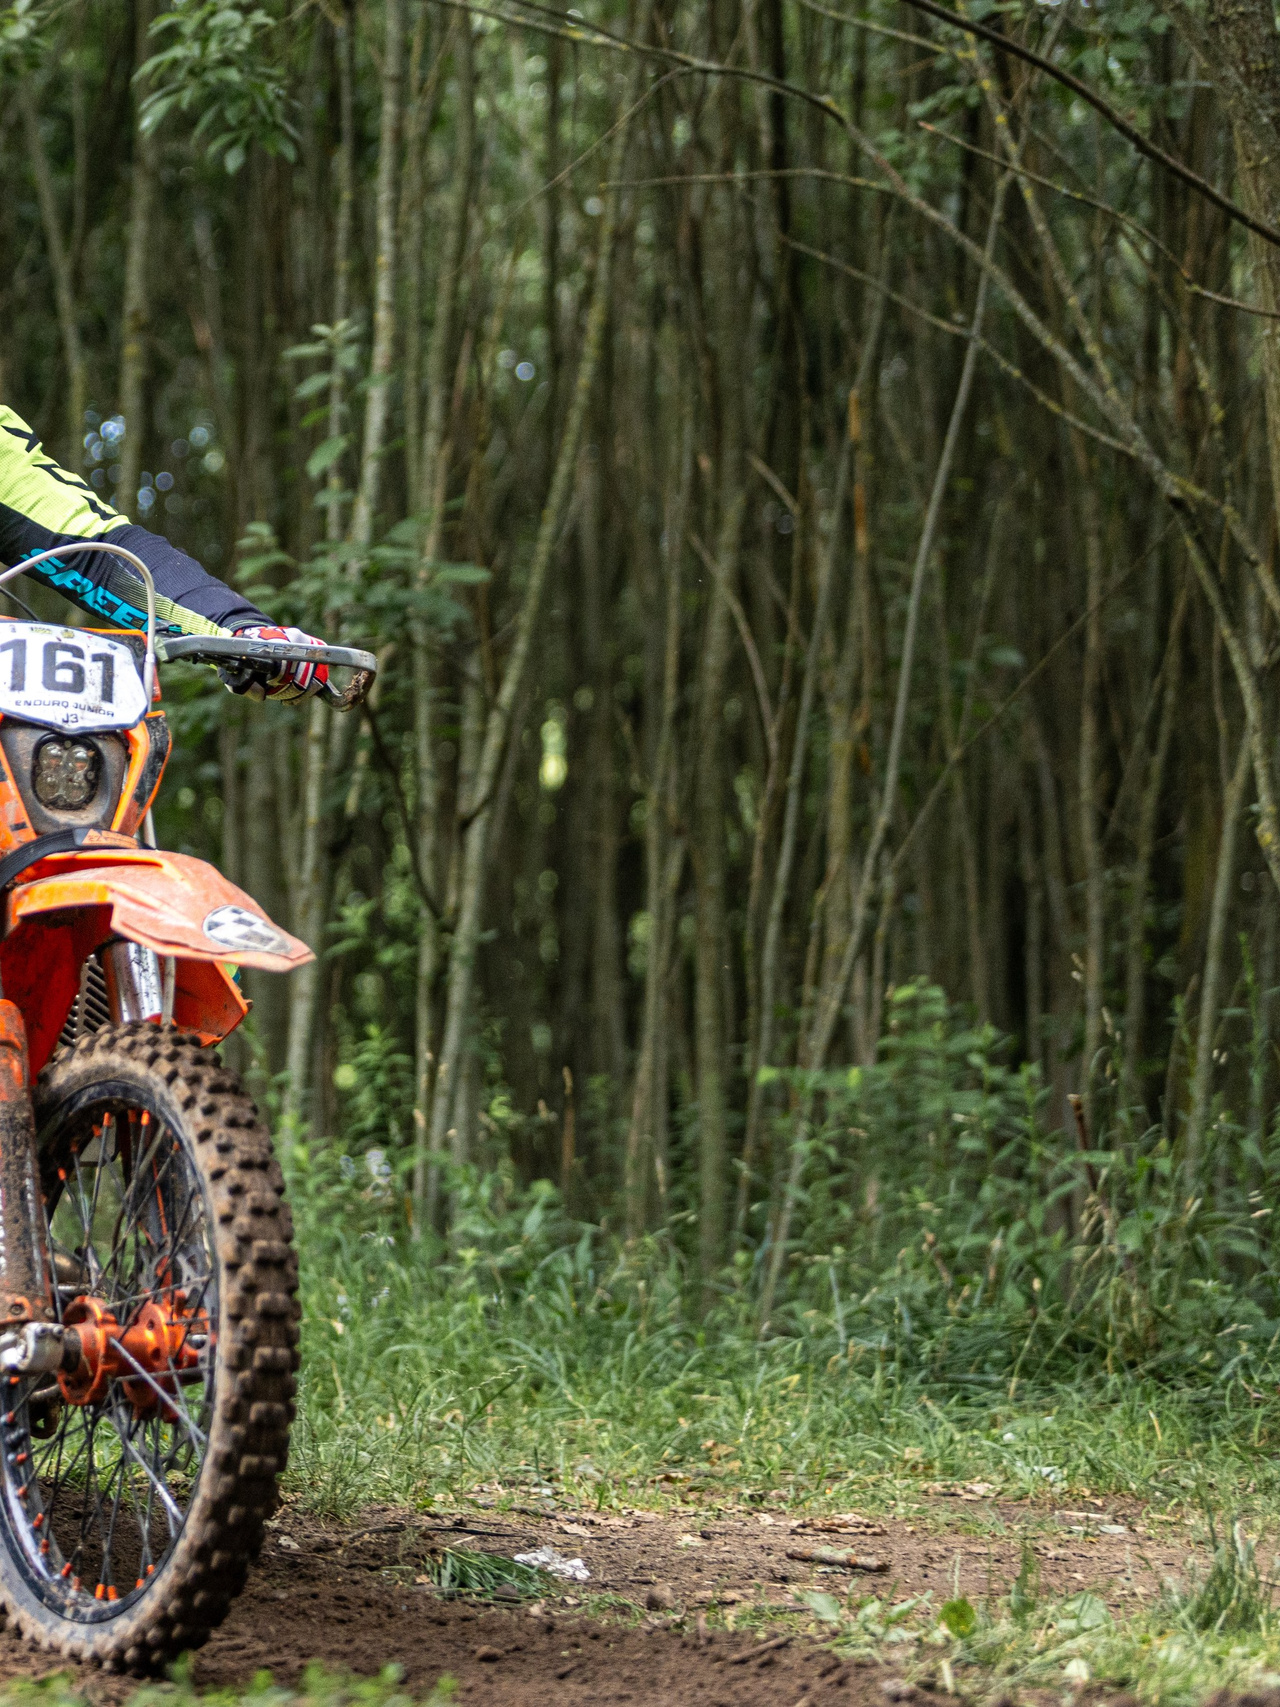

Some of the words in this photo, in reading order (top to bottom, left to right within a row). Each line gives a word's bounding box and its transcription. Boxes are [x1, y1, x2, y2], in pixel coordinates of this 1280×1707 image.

[20, 548, 156, 633] SPEE
[0, 638, 115, 704] 161
[14, 699, 69, 709] ENDURO
[72, 702, 115, 718] JUNIOR
[61, 713, 79, 724] J3
